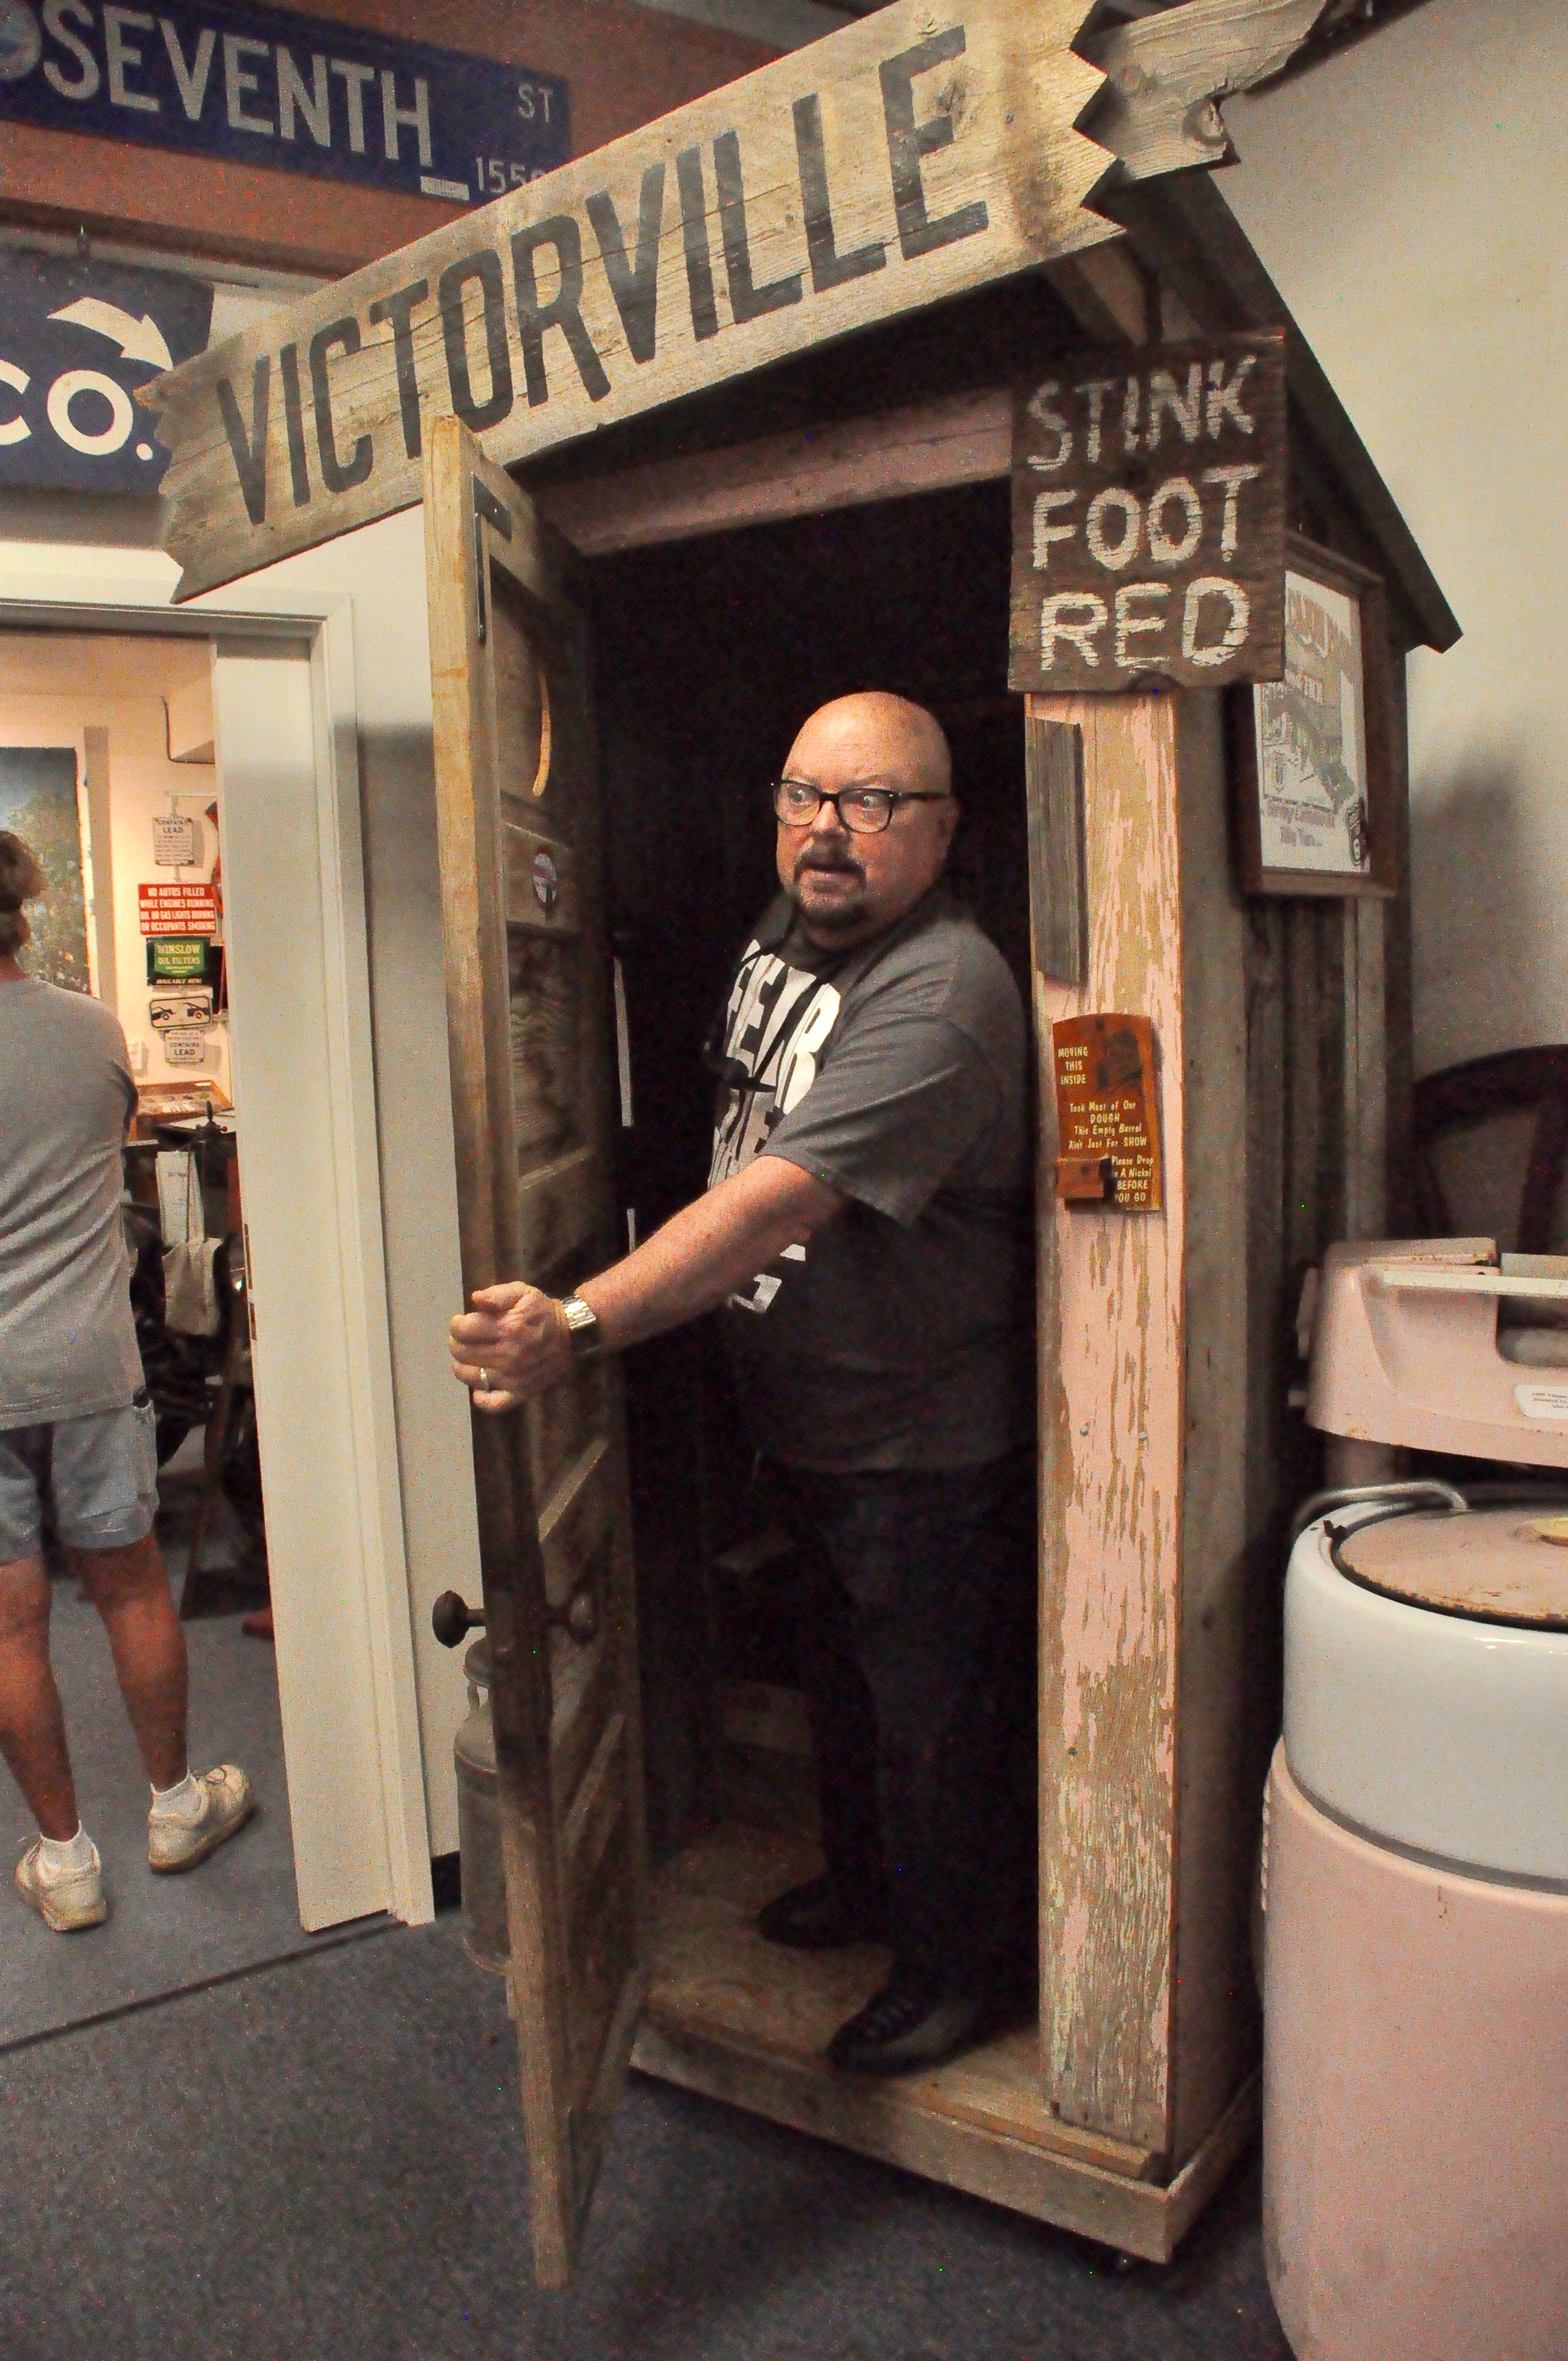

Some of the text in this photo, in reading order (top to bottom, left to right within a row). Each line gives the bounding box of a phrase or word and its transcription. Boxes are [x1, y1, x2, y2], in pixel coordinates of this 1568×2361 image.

[42, 0, 433, 167] SEVENTH
[518, 83, 553, 123] ST
[475, 156, 545, 193] 155
[216, 24, 989, 526] VICTORVILLE
[1027, 354, 1255, 471] STINK
[1031, 465, 1262, 570] FOOT
[1039, 576, 1251, 672] RED
[148, 887, 205, 896] NO AUTOS FILLED
[140, 899, 214, 908] WHILE ENGINES RUNNING
[160, 910, 171, 920] GAS
[172, 910, 190, 919] LIGHTS
[151, 921, 186, 931] OCCUPANTS
[187, 921, 215, 931] SMOKING
[156, 944, 200, 954] WINSLOW
[1058, 1046, 1088, 1058] MOVING
[1065, 1060, 1082, 1071] THIS
[1060, 1074, 1086, 1085] INSIDE
[1070, 1100, 1136, 1113] Took Most of Our
[1090, 1113, 1120, 1124] DOUGH
[1074, 1123, 1142, 1137] This Empty Barrel
[1088, 1138, 1102, 1149] Just
[1107, 1138, 1118, 1148] For
[1123, 1136, 1147, 1147] SHOW
[1112, 1154, 1155, 1167] Please Drop
[1120, 1168, 1126, 1178] A
[1129, 1168, 1151, 1178] Nickel
[1117, 1179, 1148, 1190] BEFORE
[1134, 1192, 1146, 1202] GO
